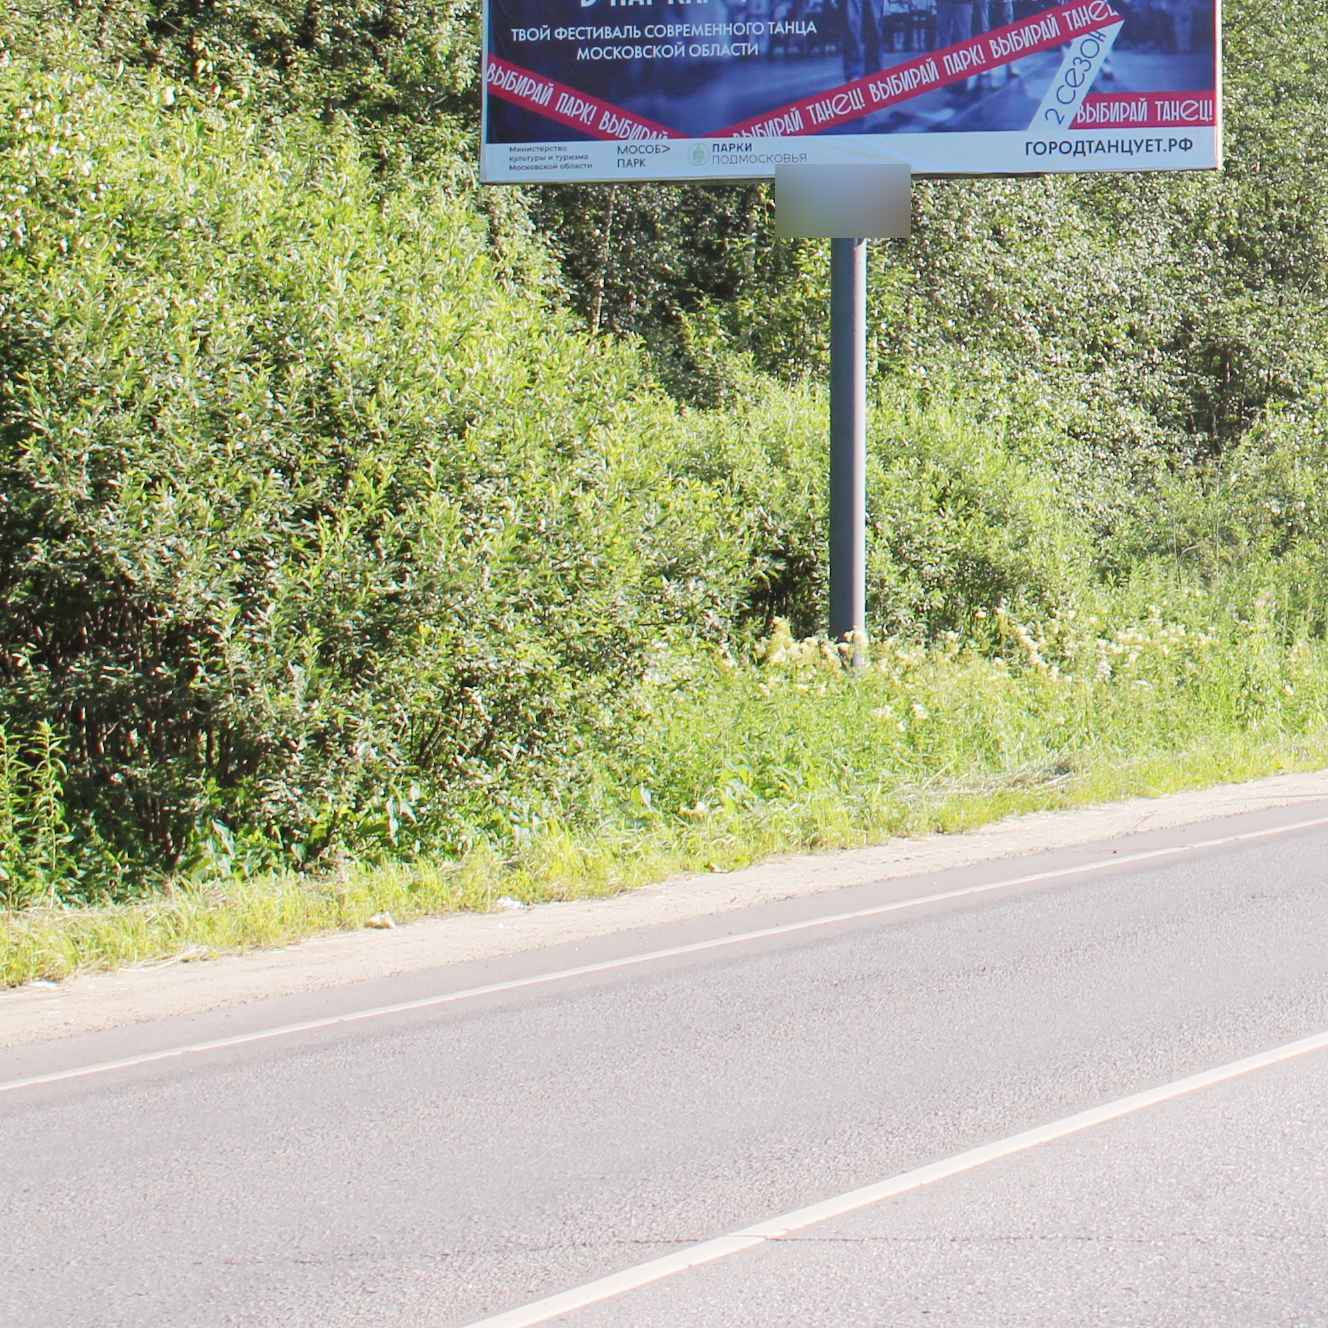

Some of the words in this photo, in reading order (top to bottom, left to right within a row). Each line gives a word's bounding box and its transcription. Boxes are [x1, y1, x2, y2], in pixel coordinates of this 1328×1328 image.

[511, 25, 551, 42] ТВОЙ
[554, 24, 642, 41] ФЕСТИВАЛЬ
[644, 21, 765, 38] СОВРЕМЕННОГО
[767, 20, 817, 37] ТАНЦА
[576, 41, 686, 61] МОСКОВСКОЙ
[688, 43, 759, 58] ОБЛАСТИ
[732, 107, 805, 138] ЫБИРАЙ
[869, 59, 940, 102] ВЫБИРАЙ
[943, 44, 985, 75] ПАРК!
[990, 16, 1060, 58] ВЫБИРАЙ
[487, 62, 554, 106] ВЫБИРАЙ
[555, 92, 598, 125] ПАРК!
[1044, 107, 1065, 125] 2
[1077, 97, 1148, 124] ВЫБИРАЙ
[509, 144, 568, 153] Министерство
[712, 142, 753, 153] ПАРКИ
[1025, 137, 1194, 157] ГОРОДТАНЦУЕТ.РФ
[508, 154, 546, 163] культуры
[556, 154, 589, 162] туризма
[508, 163, 558, 171] Московской
[616, 159, 647, 169] ПАРК
[711, 152, 808, 165] ПОДМОСКОВЬЯ
